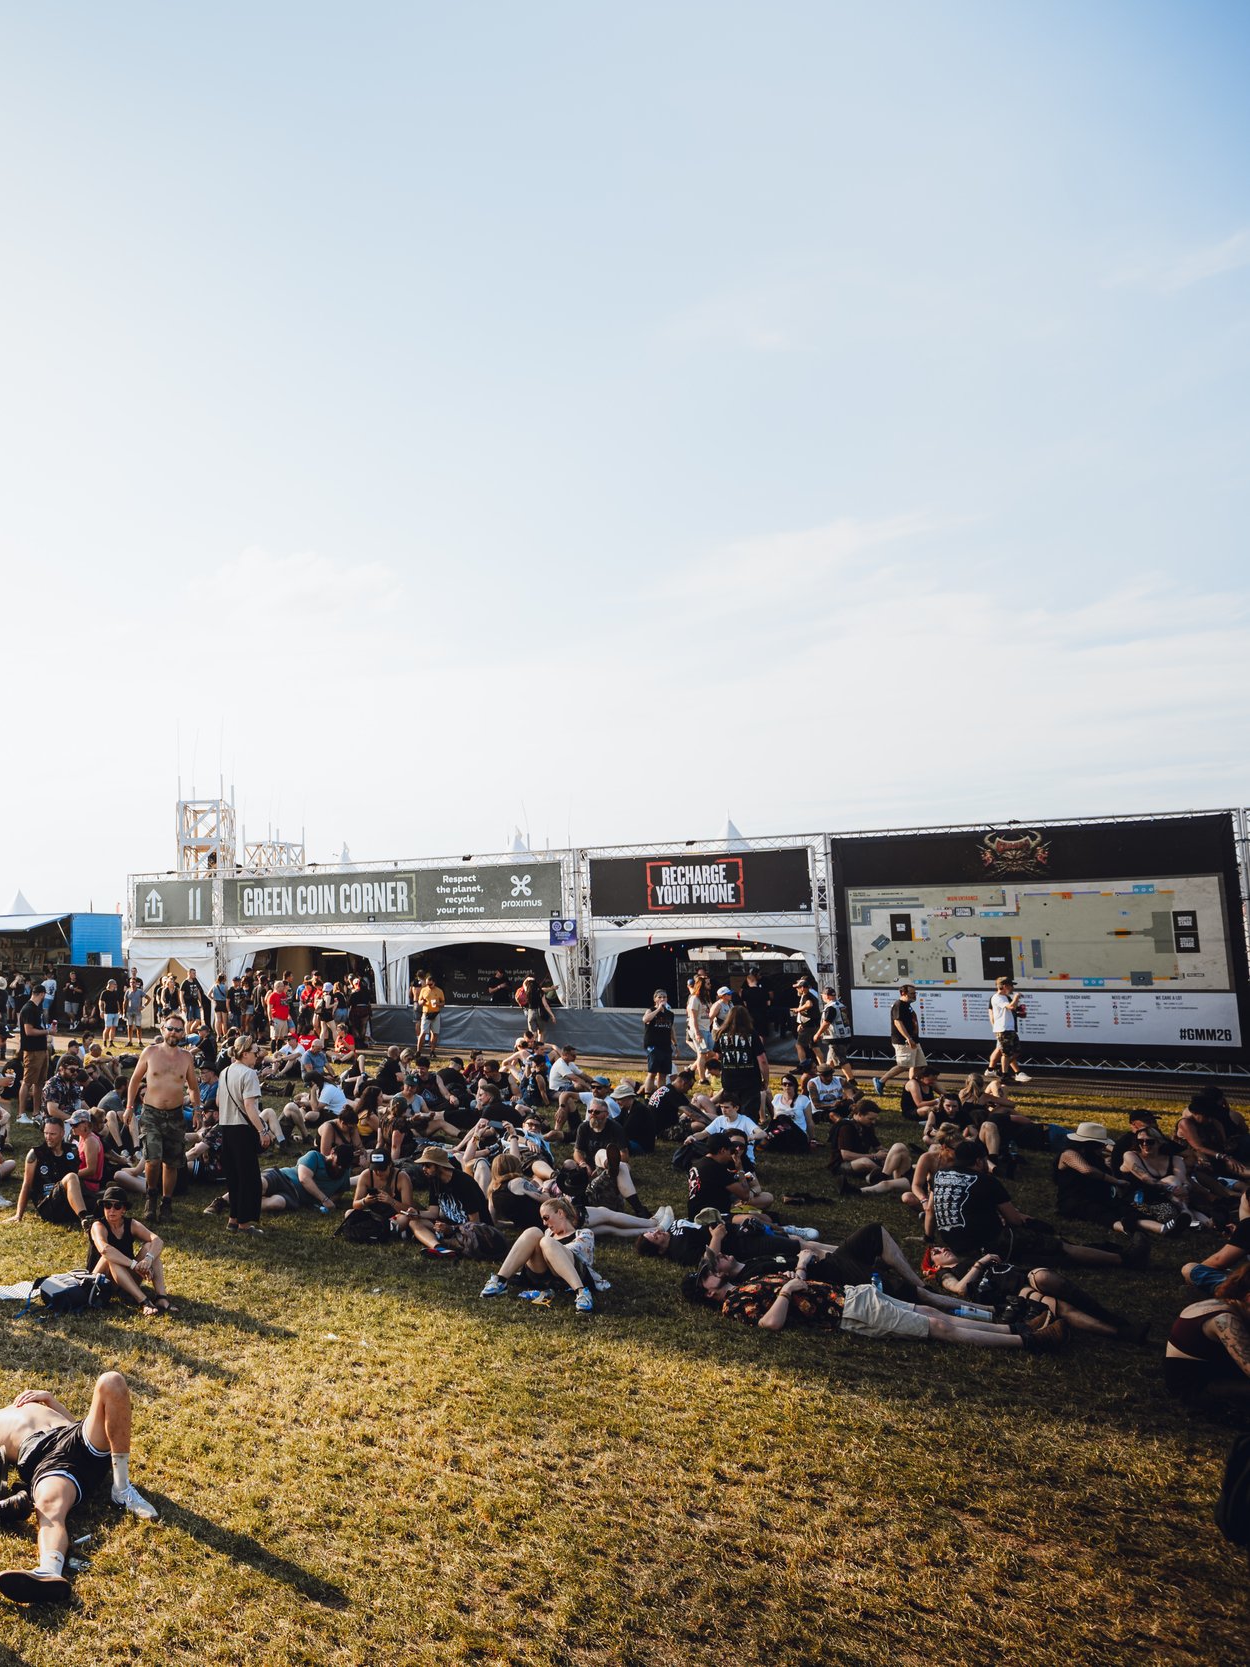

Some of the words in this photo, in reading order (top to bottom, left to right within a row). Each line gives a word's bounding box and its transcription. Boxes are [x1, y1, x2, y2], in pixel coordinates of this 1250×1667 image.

[442, 875, 477, 884] Respect
[661, 864, 727, 885] RECHARGE
[436, 886, 451, 894] the
[452, 885, 484, 895] planet,
[656, 884, 690, 905] YOUR
[692, 883, 736, 904] PHONE
[243, 886, 293, 917] GREEN
[296, 884, 336, 915] COIN
[339, 881, 410, 913] CORNER
[445, 896, 476, 905] recycle
[501, 899, 543, 909] proximus
[436, 907, 455, 915] your
[458, 906, 485, 915] phone
[452, 991, 470, 999] Your
[1179, 1028, 1233, 1042] #GMM26
